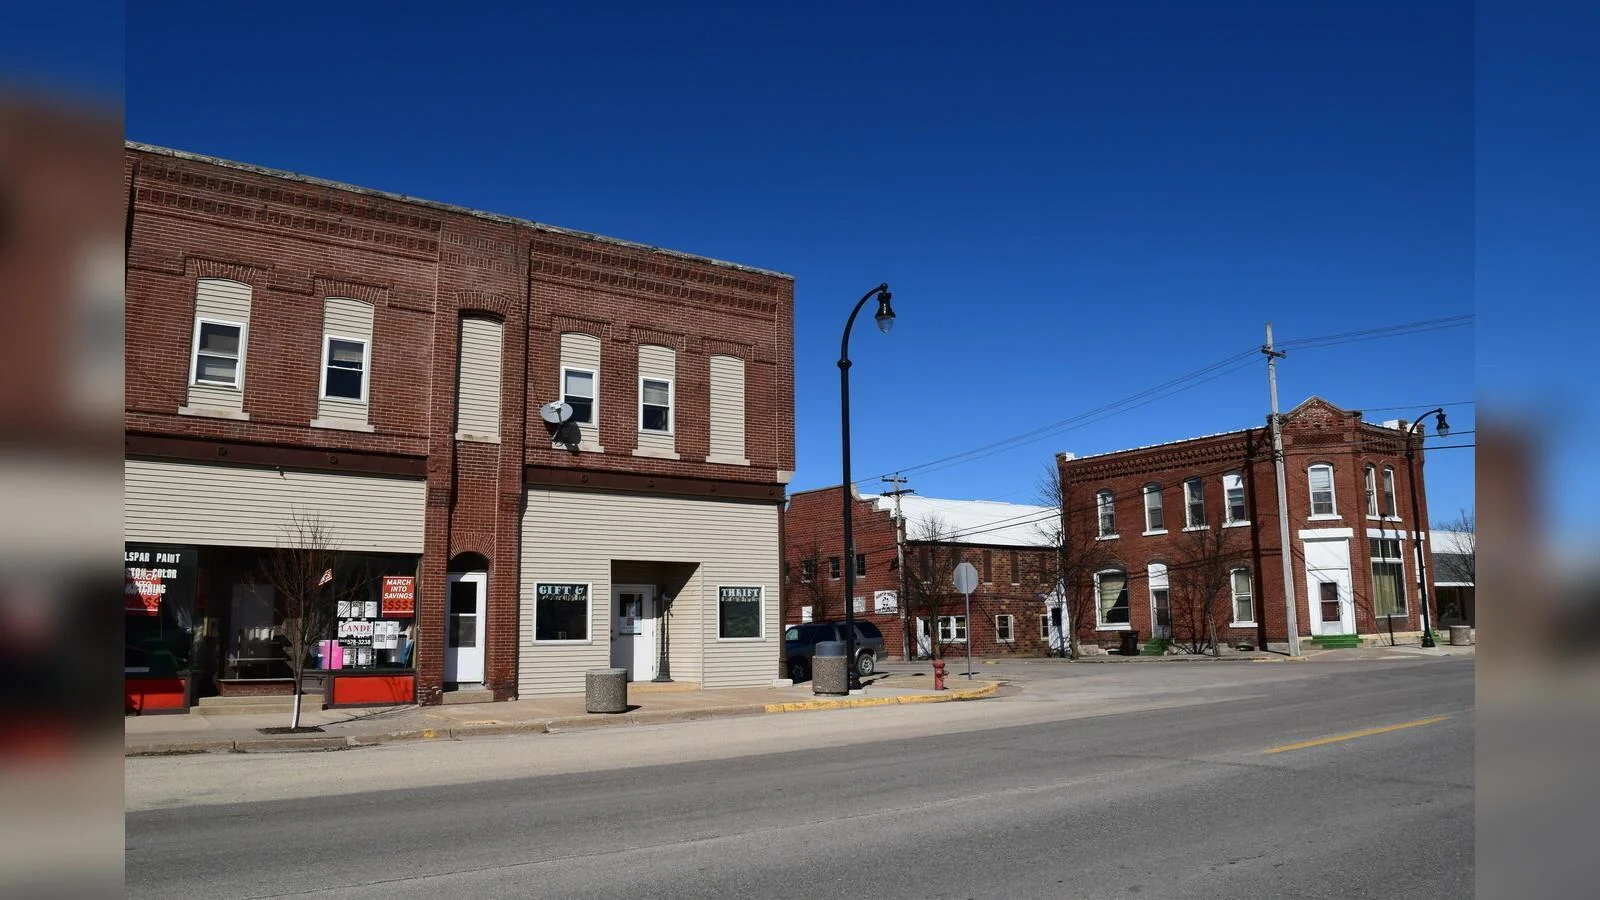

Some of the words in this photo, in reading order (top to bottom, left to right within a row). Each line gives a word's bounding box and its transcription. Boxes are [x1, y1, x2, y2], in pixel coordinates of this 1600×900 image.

[156, 553, 180, 563] PAINT
[153, 568, 177, 578] COLOR
[539, 585, 572, 595] GIFT
[574, 585, 585, 595] &
[720, 588, 759, 597] THRIFT
[341, 624, 372, 632] LANDE
